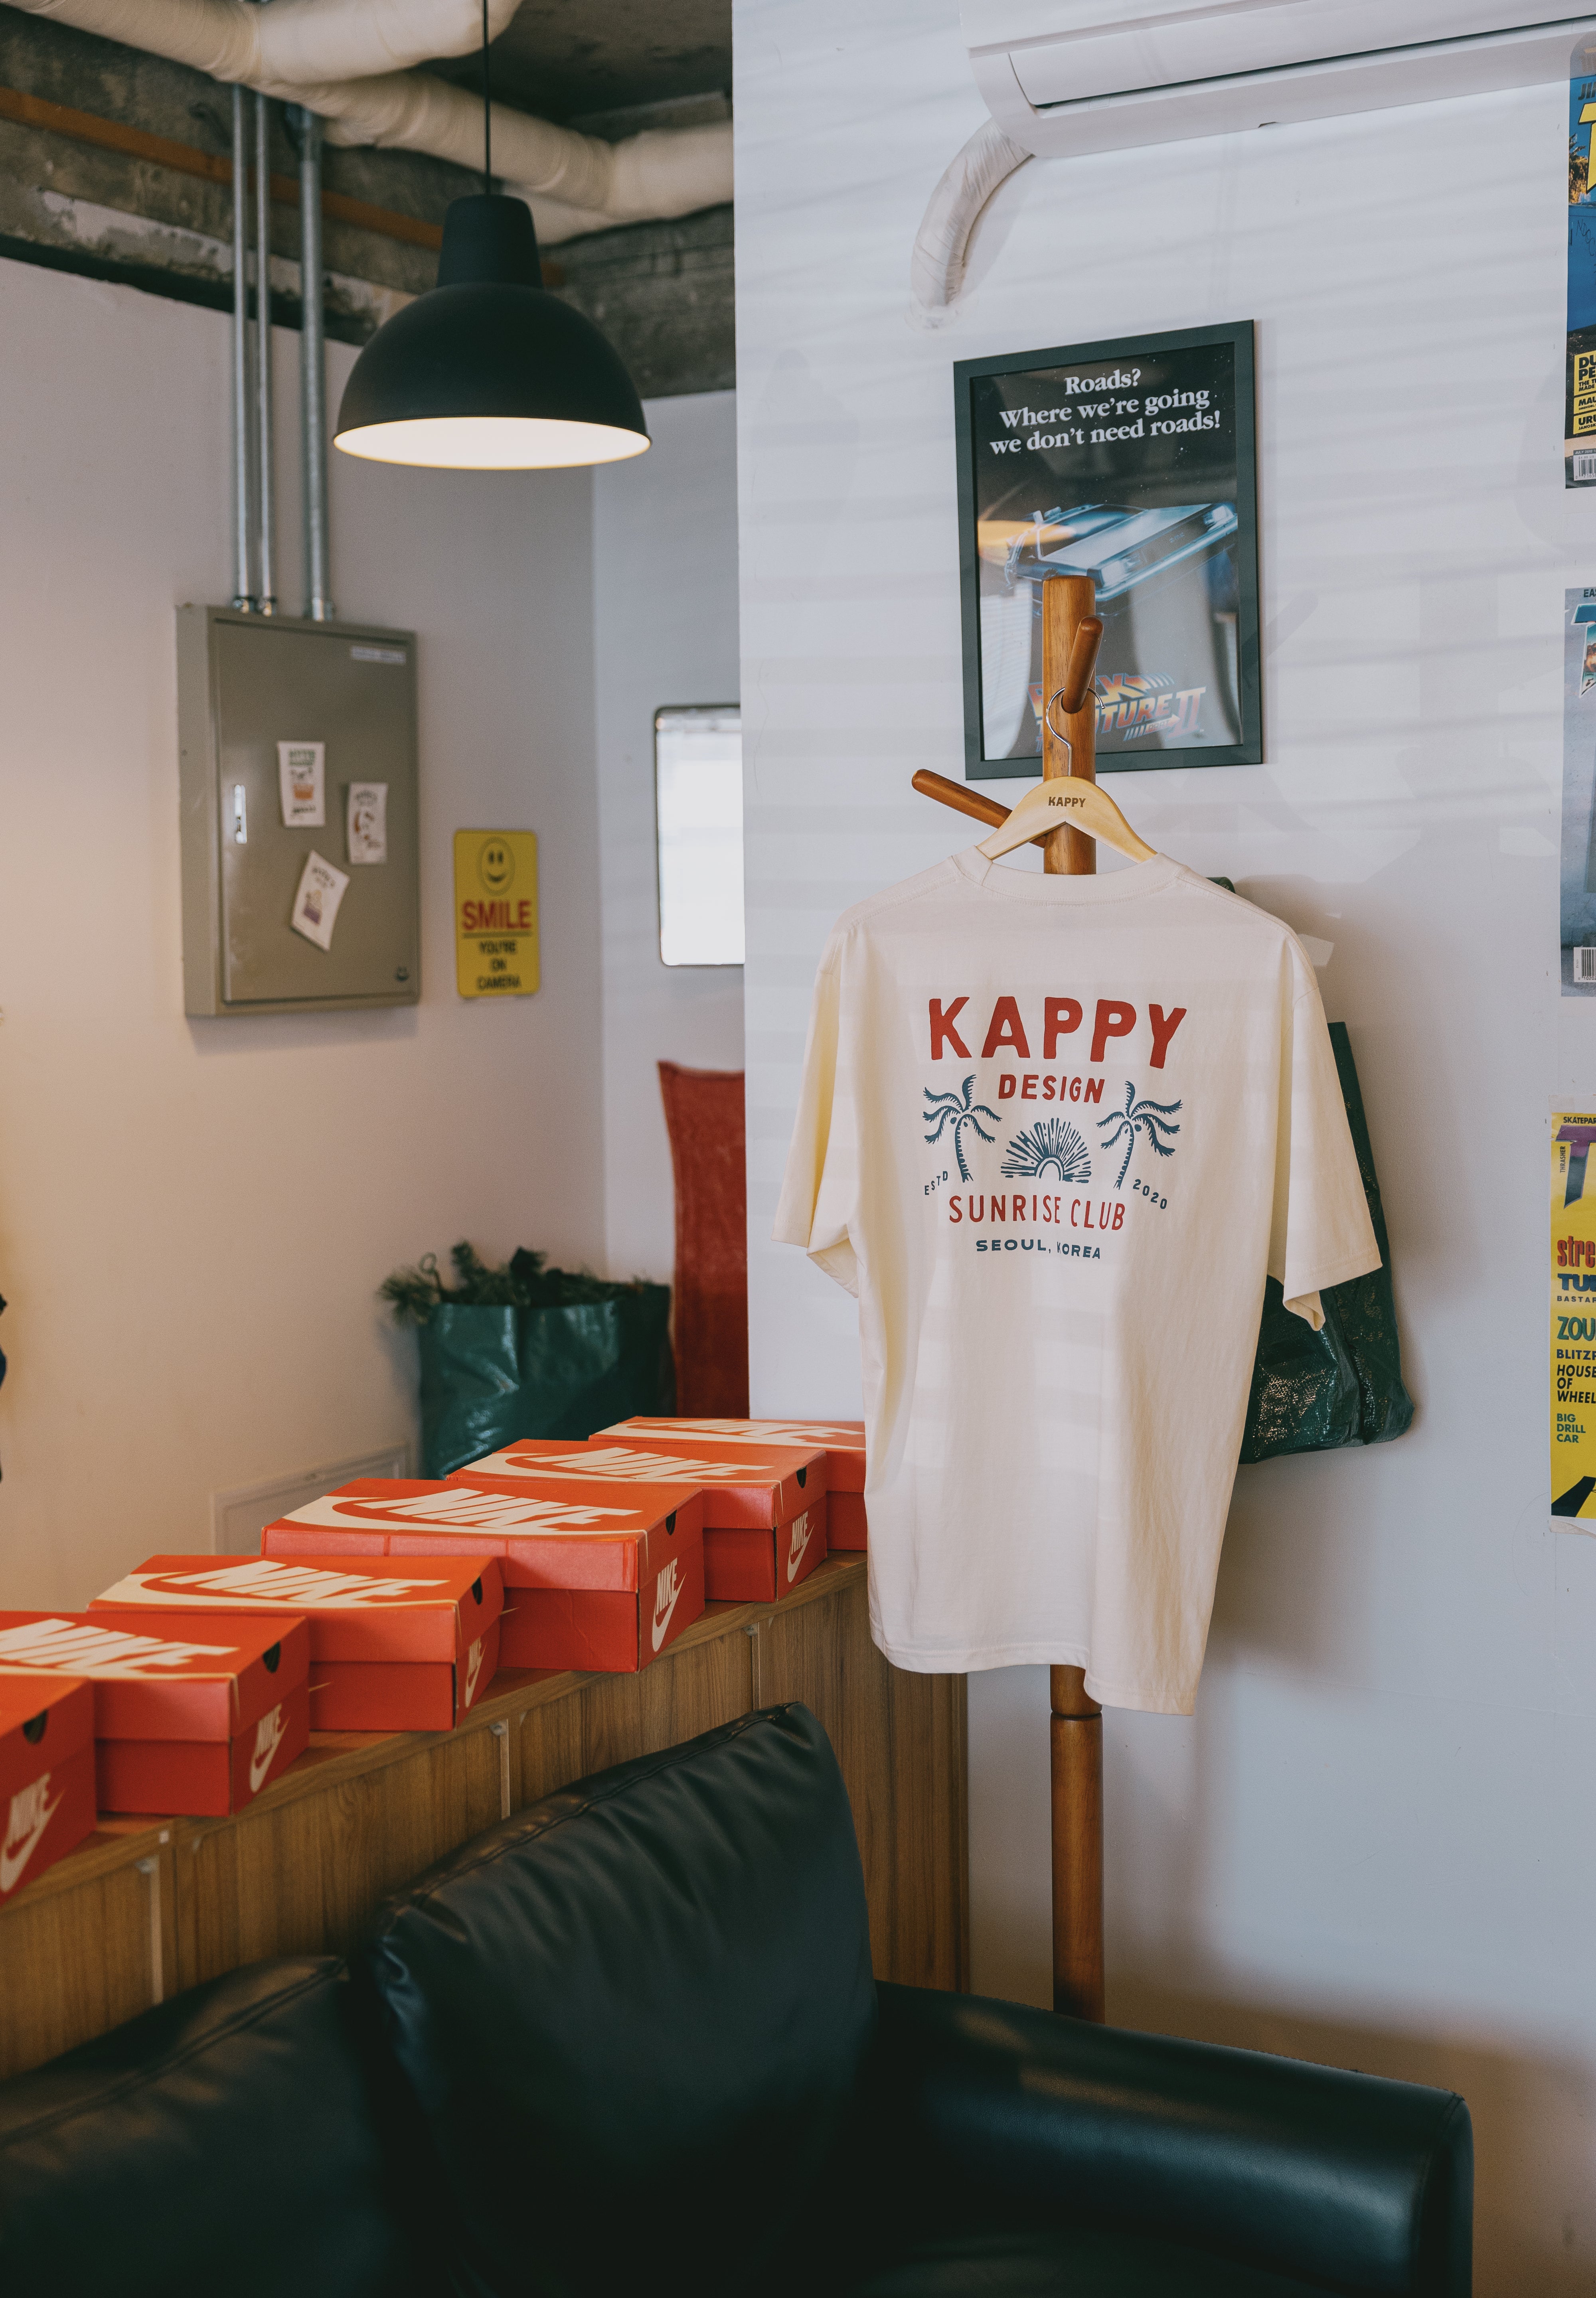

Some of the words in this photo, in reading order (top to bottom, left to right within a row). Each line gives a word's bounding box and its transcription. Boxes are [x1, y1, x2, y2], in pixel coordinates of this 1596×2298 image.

[1579, 355, 1596, 369] DU
[1579, 366, 1596, 381] PE
[1065, 368, 1141, 395] Roads?
[999, 407, 1072, 430] Where
[1077, 397, 1139, 420] we're
[1145, 388, 1210, 415] going
[990, 437, 1021, 455] we
[1026, 428, 1084, 450] don't
[1090, 423, 1144, 444] need
[1151, 410, 1220, 436] roads!
[1584, 588, 1596, 597] EA
[1096, 694, 1173, 734] TURE
[1048, 797, 1086, 807] KAPPY
[462, 900, 532, 930] SMILE
[929, 996, 1187, 1069] KAPPY
[998, 1074, 1105, 1103] DESIGN
[924, 1171, 948, 1195] ESTD
[1132, 1179, 1167, 1209] 2020
[949, 1194, 1061, 1224] SUNRISE
[1071, 1199, 1125, 1230] CLUB
[976, 1239, 1051, 1254] SEOUL,
[1057, 1242, 1101, 1260] KOREA
[1557, 1236, 1596, 1268] stre
[1557, 1316, 1596, 1341] ZOU
[1557, 1364, 1596, 1378] HOUSE
[1557, 1377, 1573, 1389] OF
[1557, 1390, 1596, 1404] WHEEL
[652, 1419, 865, 1443] NIKE
[1557, 1413, 1576, 1422] BIG
[1557, 1423, 1586, 1433] DRILL
[1556, 1433, 1579, 1443] CAR
[523, 1447, 775, 1479] NIKE
[353, 1488, 643, 1531] NIKE
[791, 1511, 809, 1555] NIKE
[158, 1560, 451, 1602] NIKE
[656, 1557, 678, 1616] NIKE
